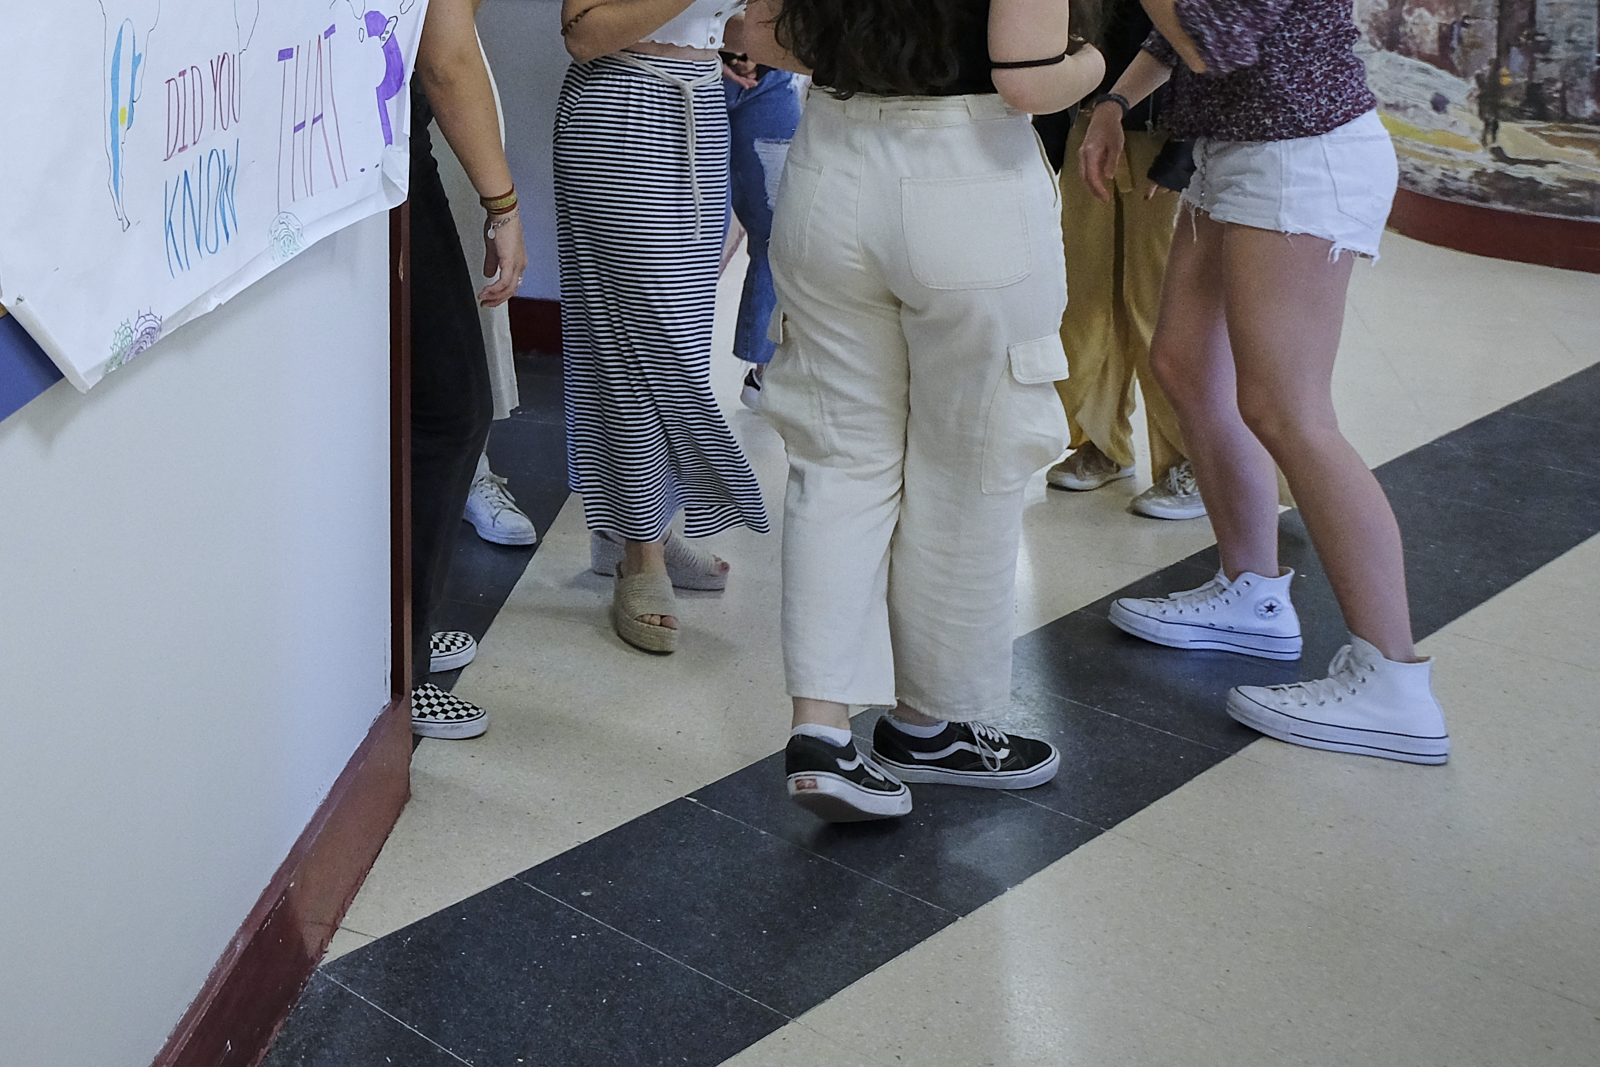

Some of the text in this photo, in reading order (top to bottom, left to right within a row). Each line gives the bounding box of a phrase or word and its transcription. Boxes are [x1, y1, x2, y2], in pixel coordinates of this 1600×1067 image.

[163, 51, 242, 162] DID YOU
[164, 138, 241, 279] KNOW
